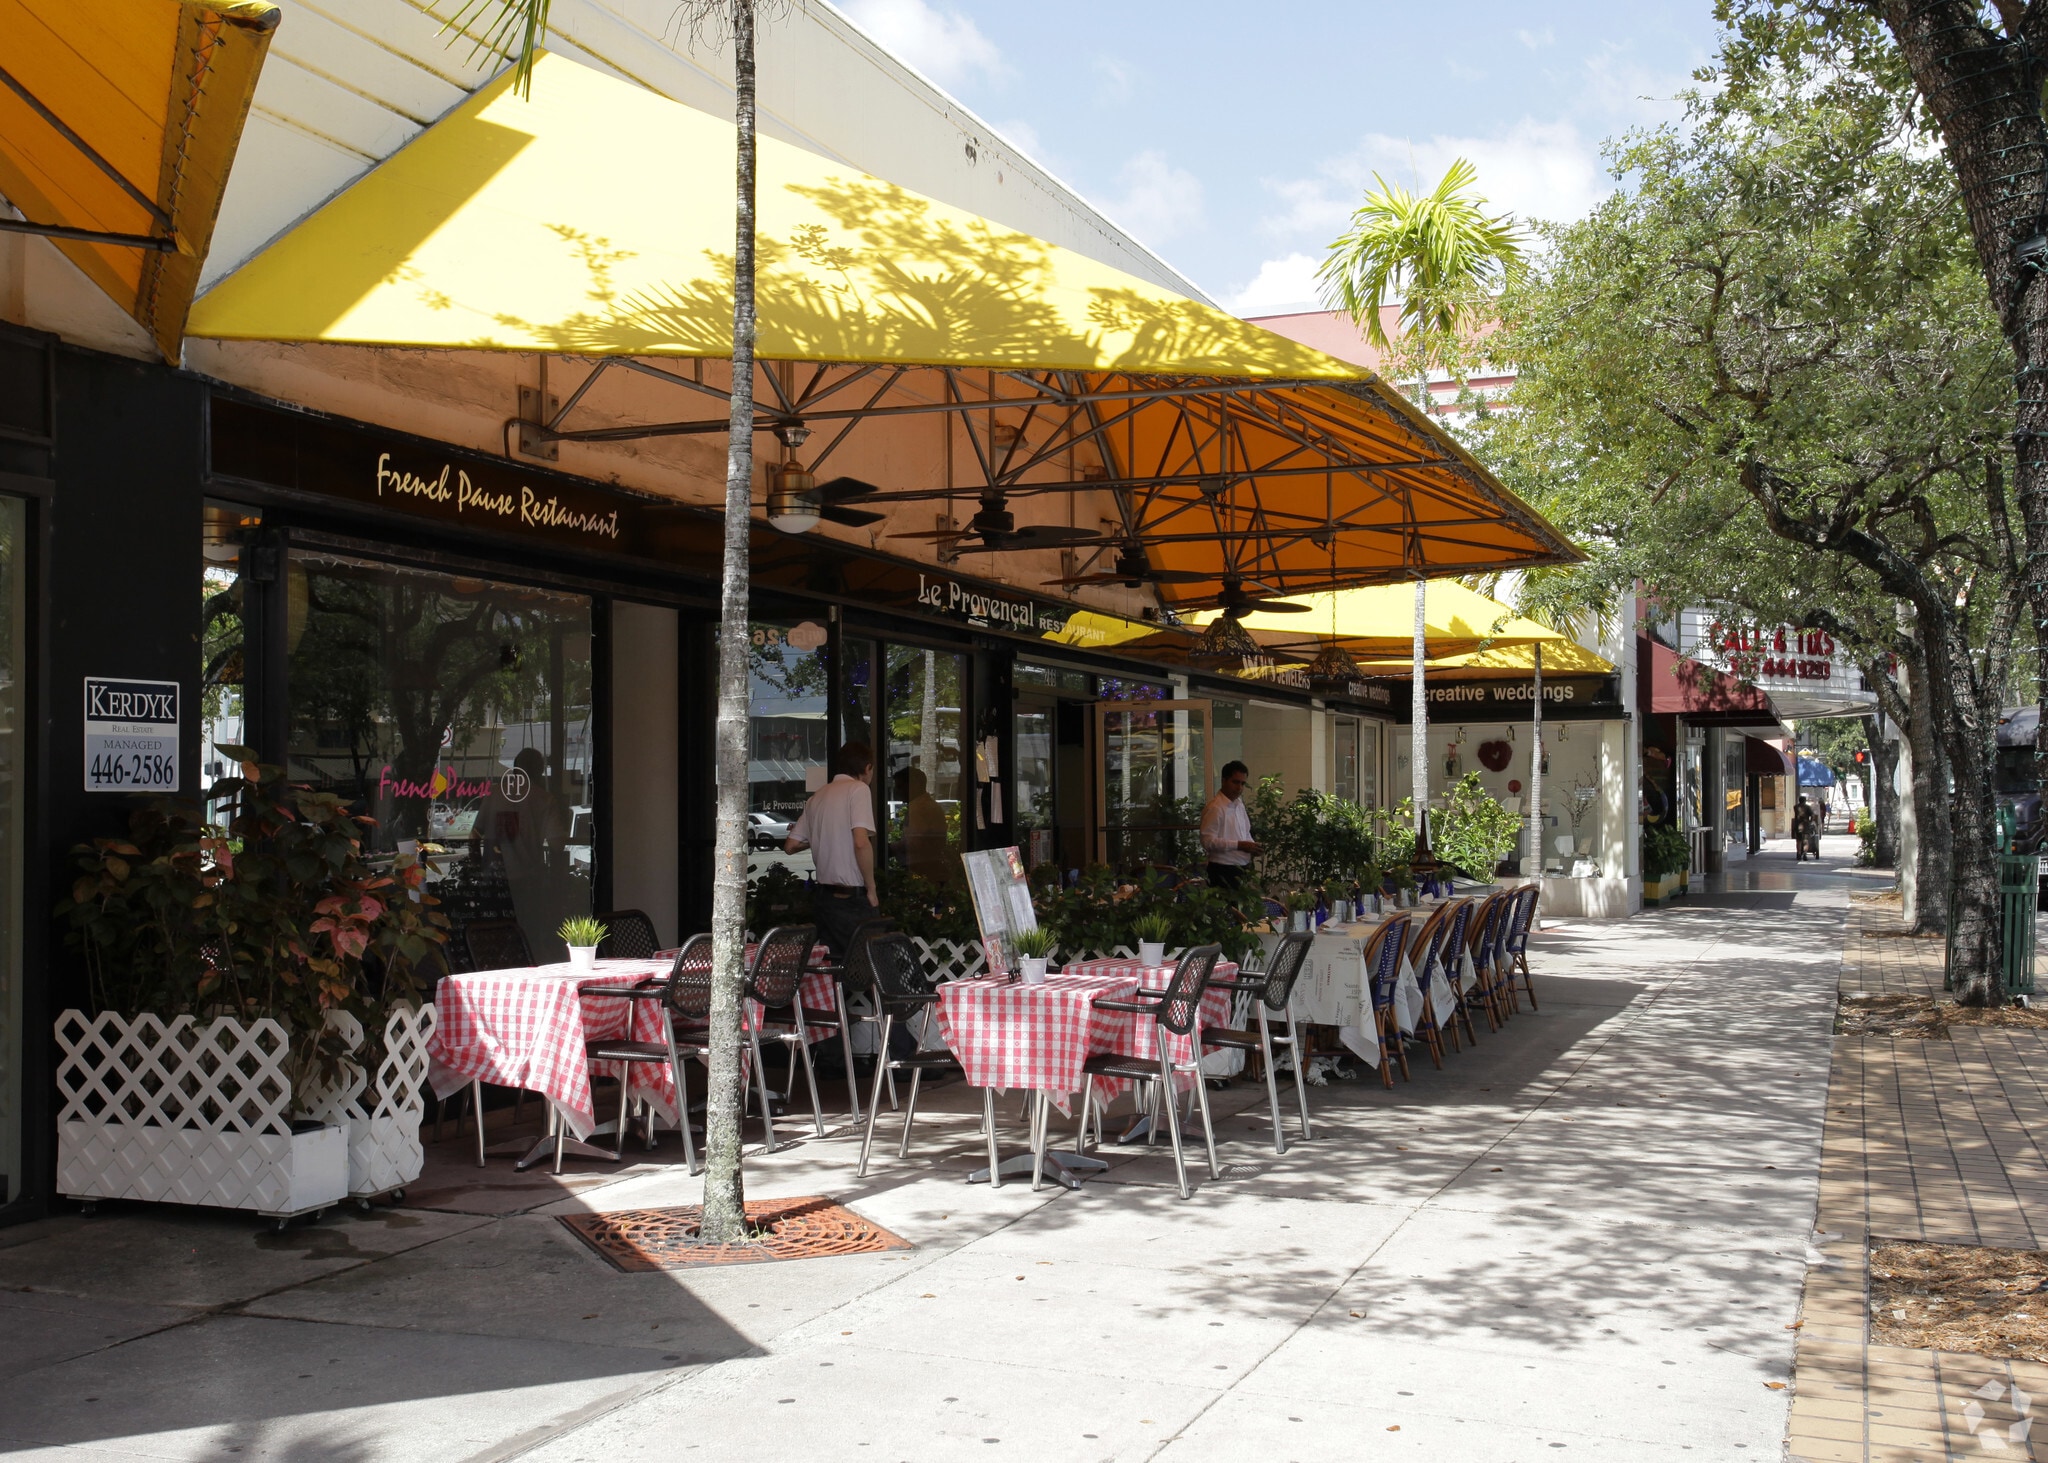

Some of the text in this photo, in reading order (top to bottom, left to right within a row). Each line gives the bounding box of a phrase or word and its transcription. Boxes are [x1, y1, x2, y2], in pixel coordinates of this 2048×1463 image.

[376, 453, 619, 539] French Pause Restaurant
[918, 573, 1106, 641] Le Provençal RESTAURANT
[89, 684, 175, 719] KERDYK
[1348, 681, 1391, 705] creative weddings
[1493, 683, 1575, 703] weddngs
[103, 739, 162, 750] MANAGED
[90, 754, 174, 785] 446-2586
[379, 765, 492, 801] French Pause
[505, 773, 525, 796] FP
[762, 801, 771, 811] Le
